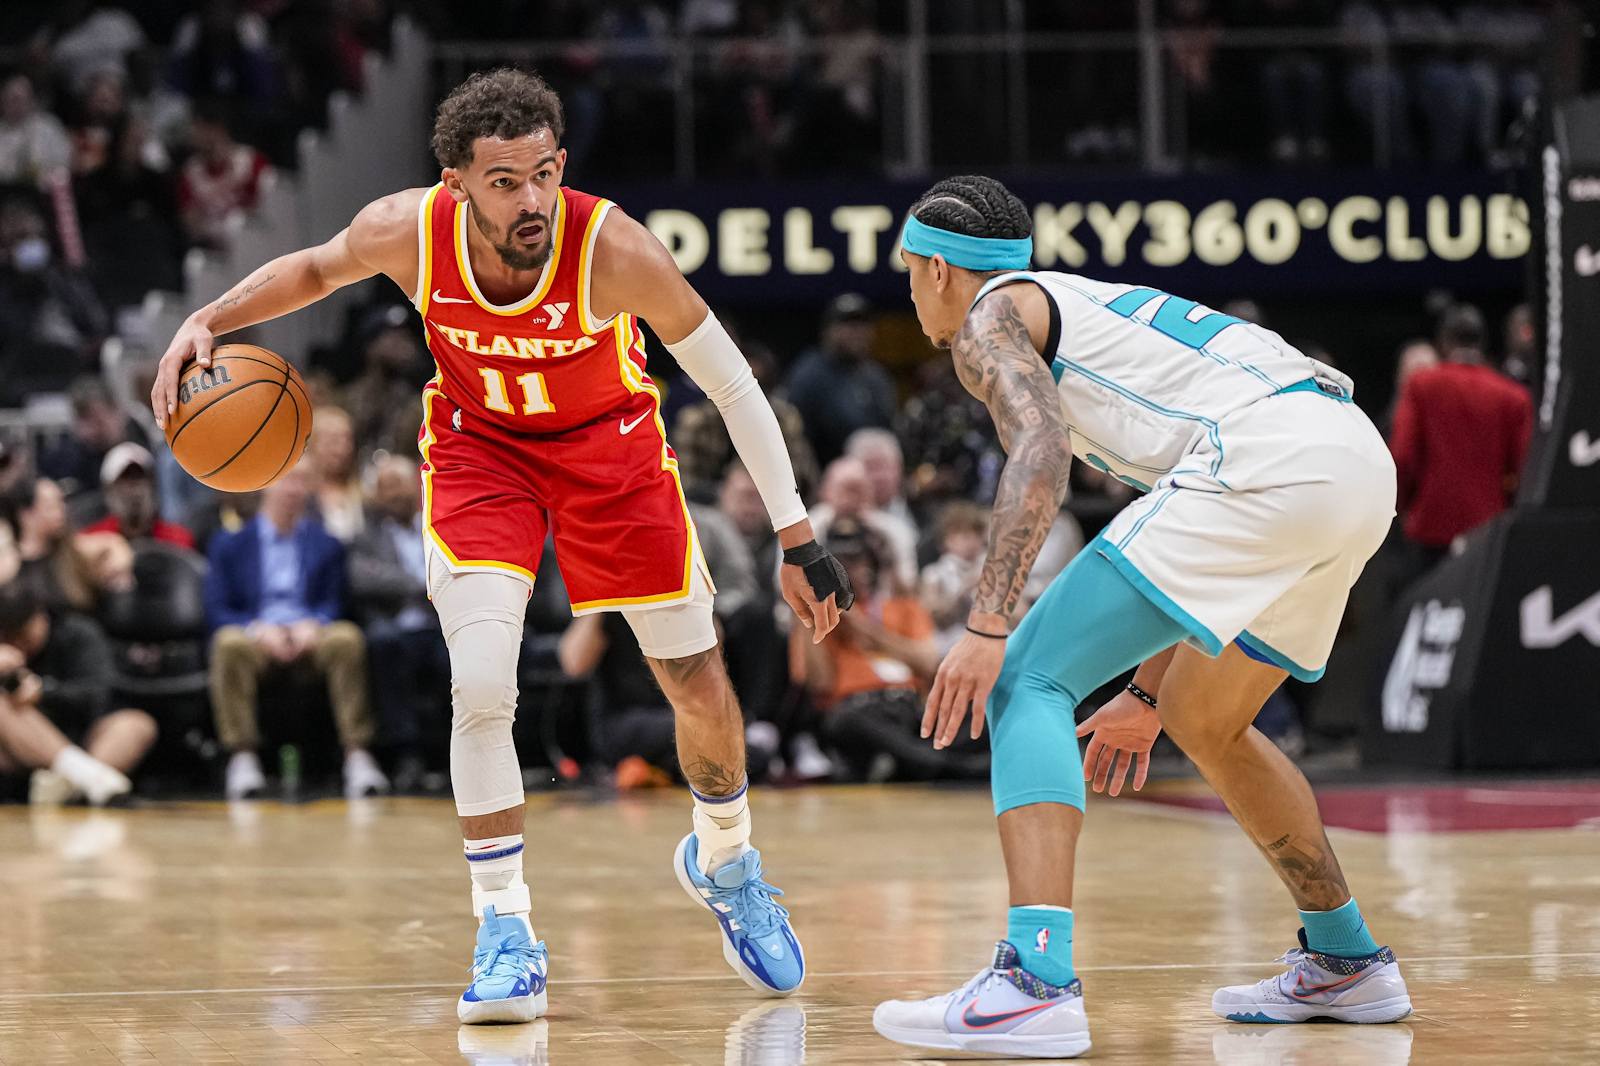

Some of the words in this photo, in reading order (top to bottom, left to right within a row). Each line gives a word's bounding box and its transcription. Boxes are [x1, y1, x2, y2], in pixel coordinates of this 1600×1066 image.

[646, 205, 910, 276] DELT
[428, 319, 597, 358] TLANTA
[477, 366, 556, 416] 11
